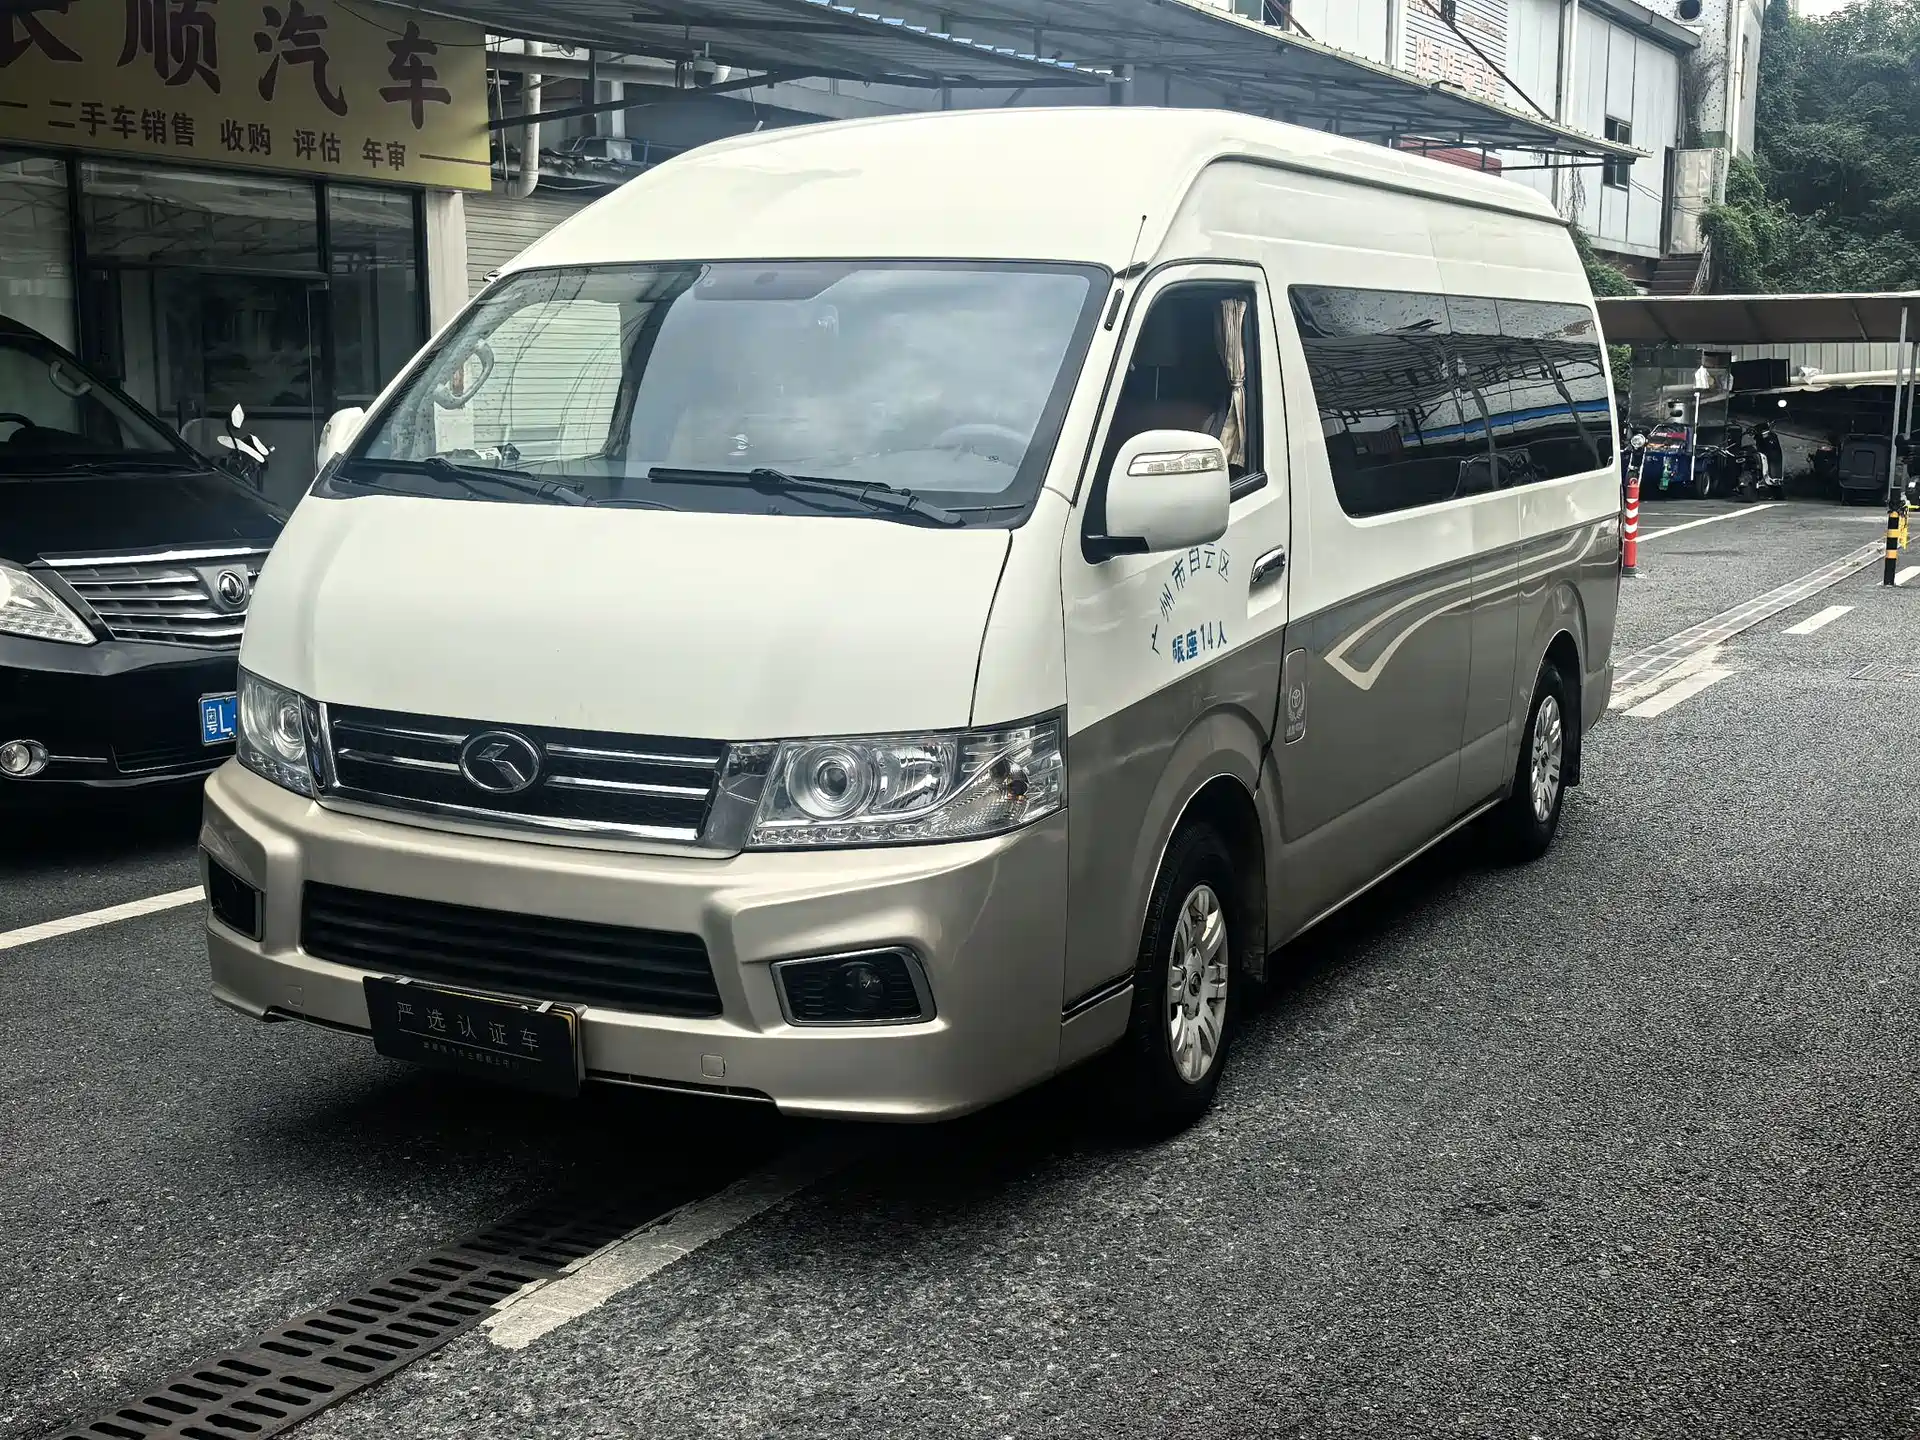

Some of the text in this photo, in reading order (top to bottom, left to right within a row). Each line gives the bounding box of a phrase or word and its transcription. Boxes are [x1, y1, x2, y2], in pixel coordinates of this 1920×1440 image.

[48, 100, 407, 171] 二手车销售 收购 评估 年审
[397, 1000, 540, 1051] 严选认证车
